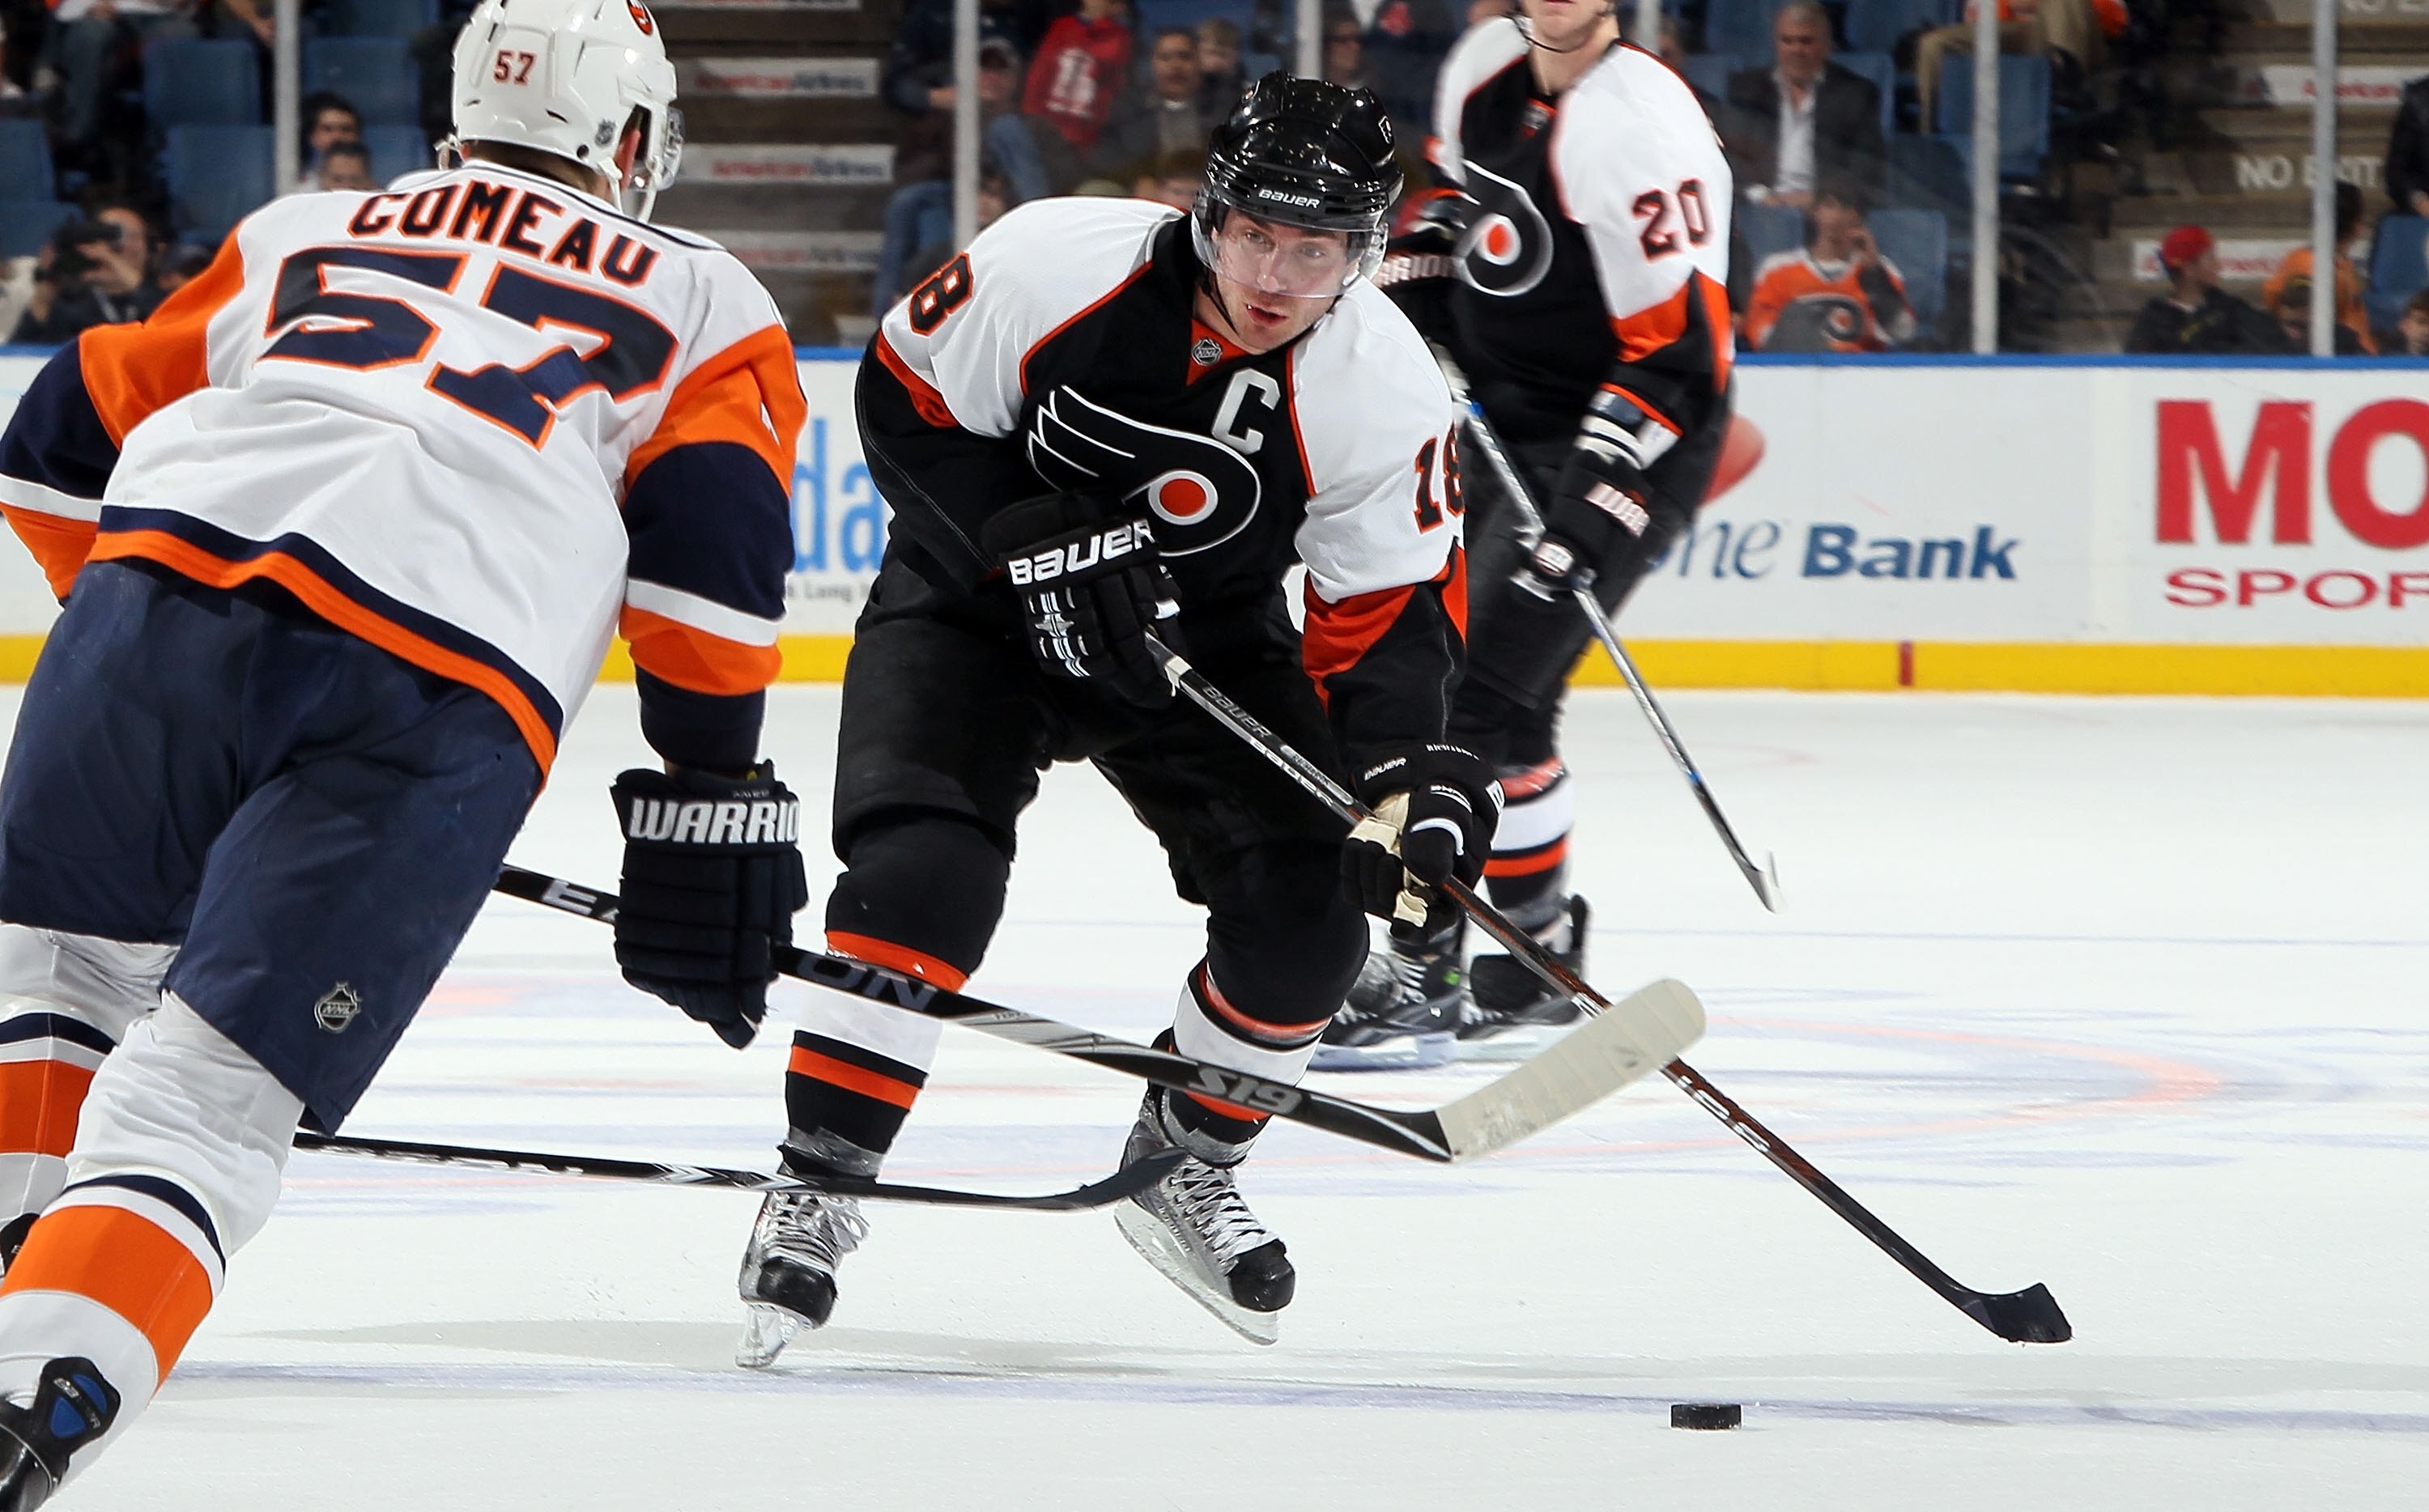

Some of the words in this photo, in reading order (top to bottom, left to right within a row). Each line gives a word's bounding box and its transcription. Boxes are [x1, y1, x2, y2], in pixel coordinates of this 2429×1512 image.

[493, 49, 538, 87] 57
[1258, 189, 1321, 209] BAUER
[2237, 155, 2295, 189] NO
[347, 180, 661, 287] COMEAU
[1631, 173, 1716, 265] 20
[252, 244, 680, 453] 57
[1211, 367, 1281, 455] C
[1414, 419, 1466, 535] 18
[1008, 518, 1155, 585] BAUER
[1660, 519, 1780, 580] ne
[1802, 523, 2022, 580] Bank
[1202, 687, 1272, 738] BAUER
[629, 797, 801, 844] WARRIO
[1188, 1066, 1303, 1115] S19
